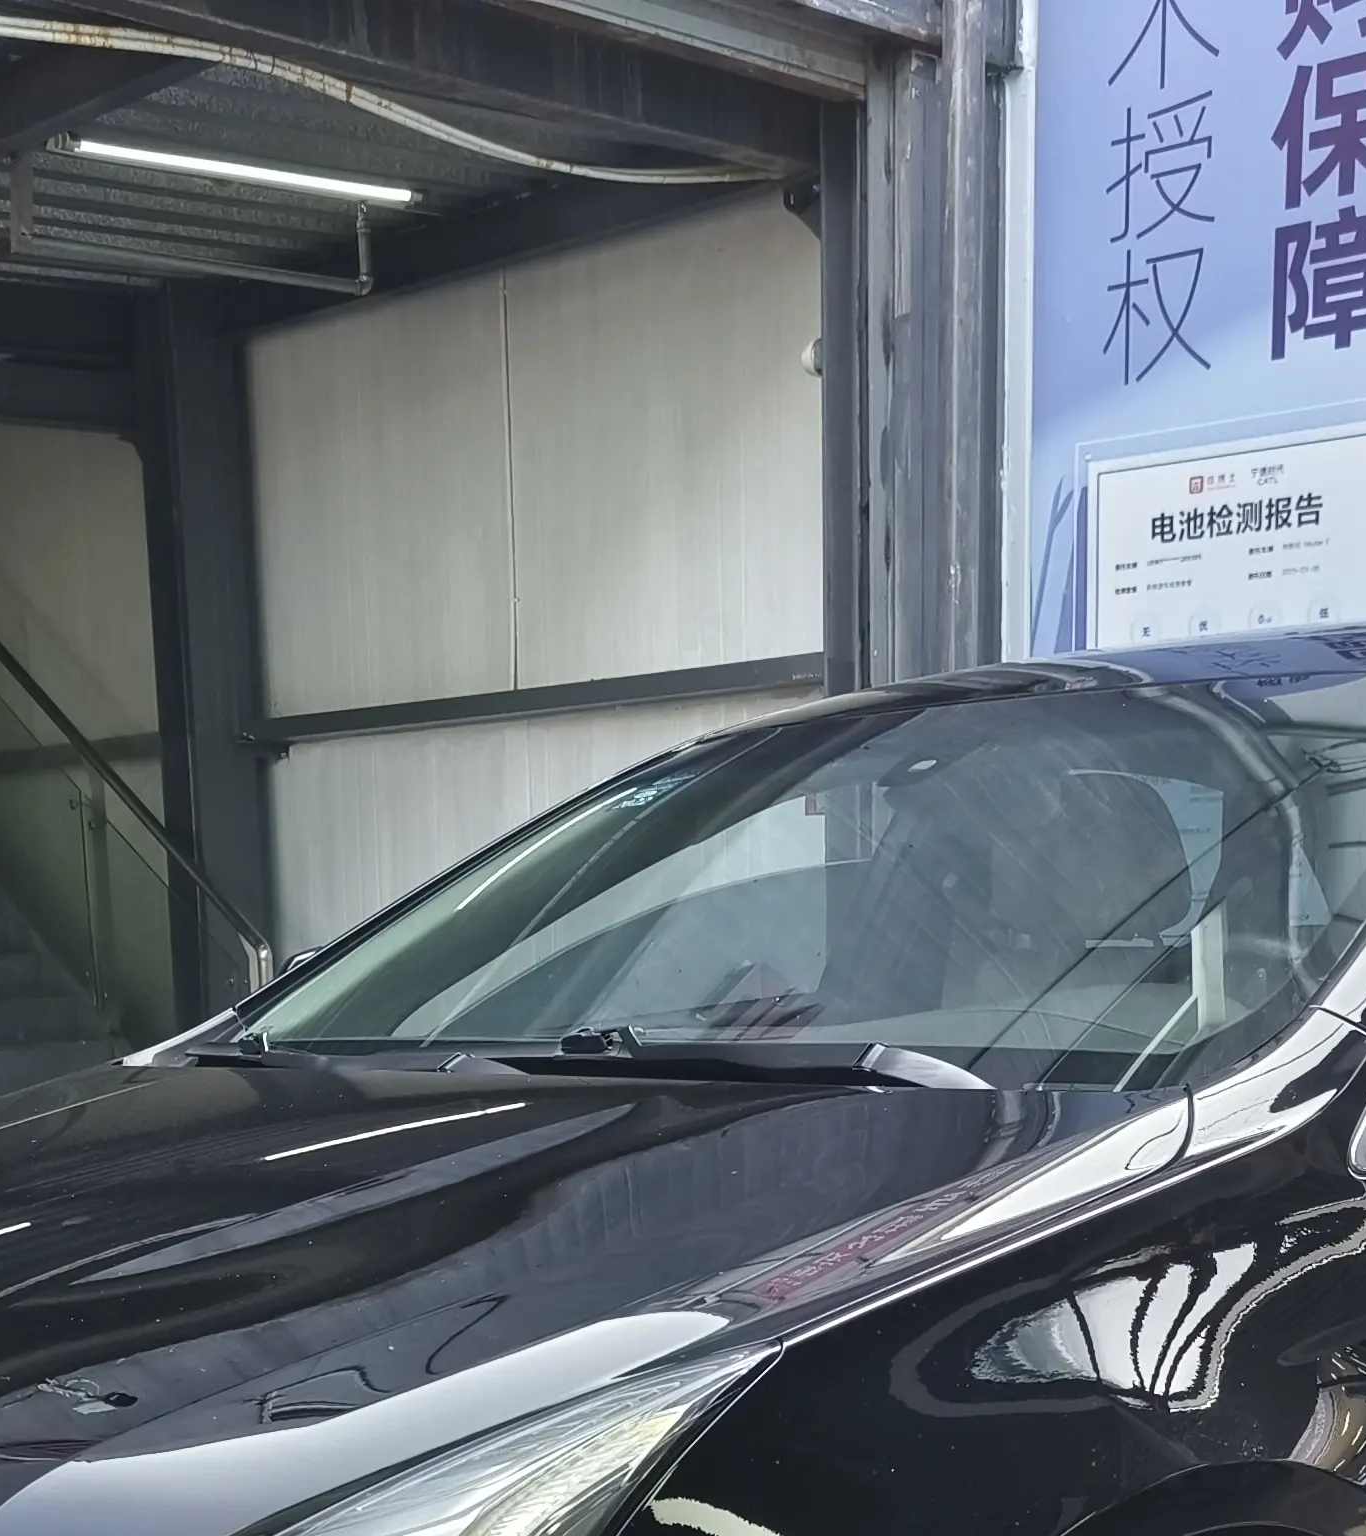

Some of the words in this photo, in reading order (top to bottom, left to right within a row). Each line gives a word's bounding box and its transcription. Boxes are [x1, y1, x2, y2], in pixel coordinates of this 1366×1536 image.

[1151, 492, 1324, 544] 电池检测报告
